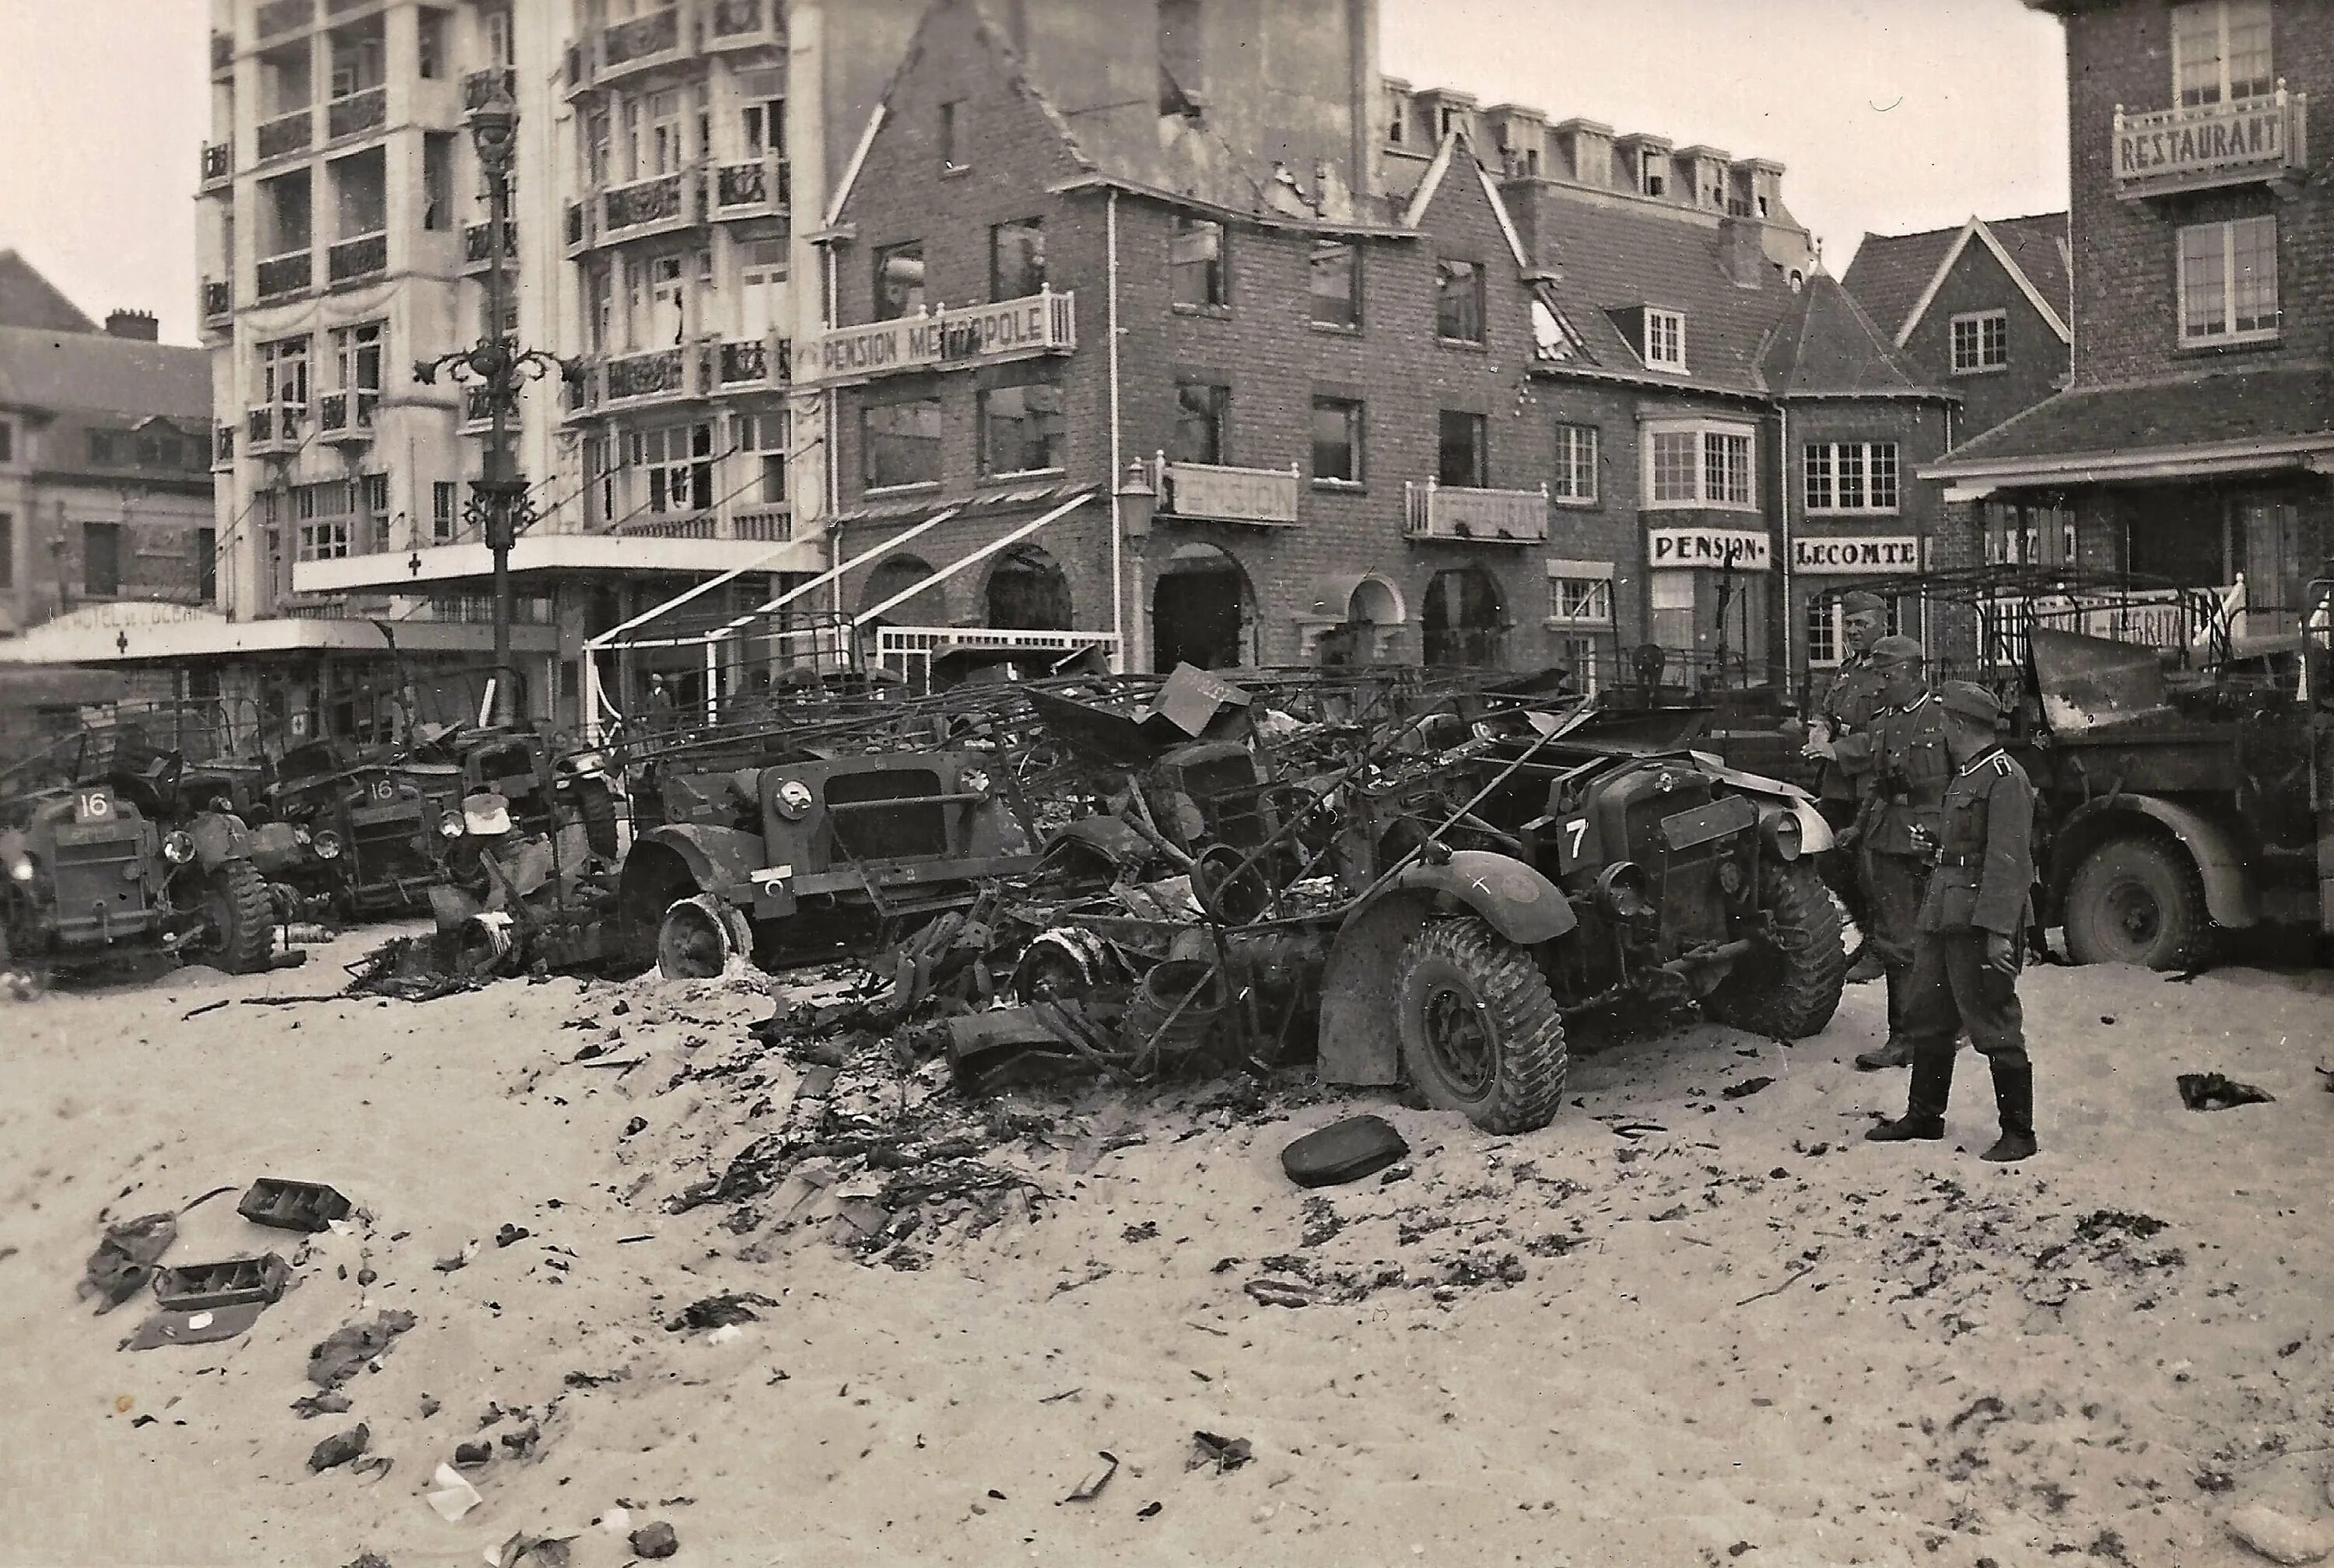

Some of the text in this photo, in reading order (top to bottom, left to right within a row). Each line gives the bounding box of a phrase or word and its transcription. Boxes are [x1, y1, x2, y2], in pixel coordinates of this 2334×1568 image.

[2121, 114, 2280, 171] RESTAURANT
[824, 329, 897, 371] PENSION
[1796, 541, 1915, 565] LECOMTE
[81, 793, 107, 817] 16
[371, 779, 393, 800] 16
[1565, 817, 1587, 859] 7
